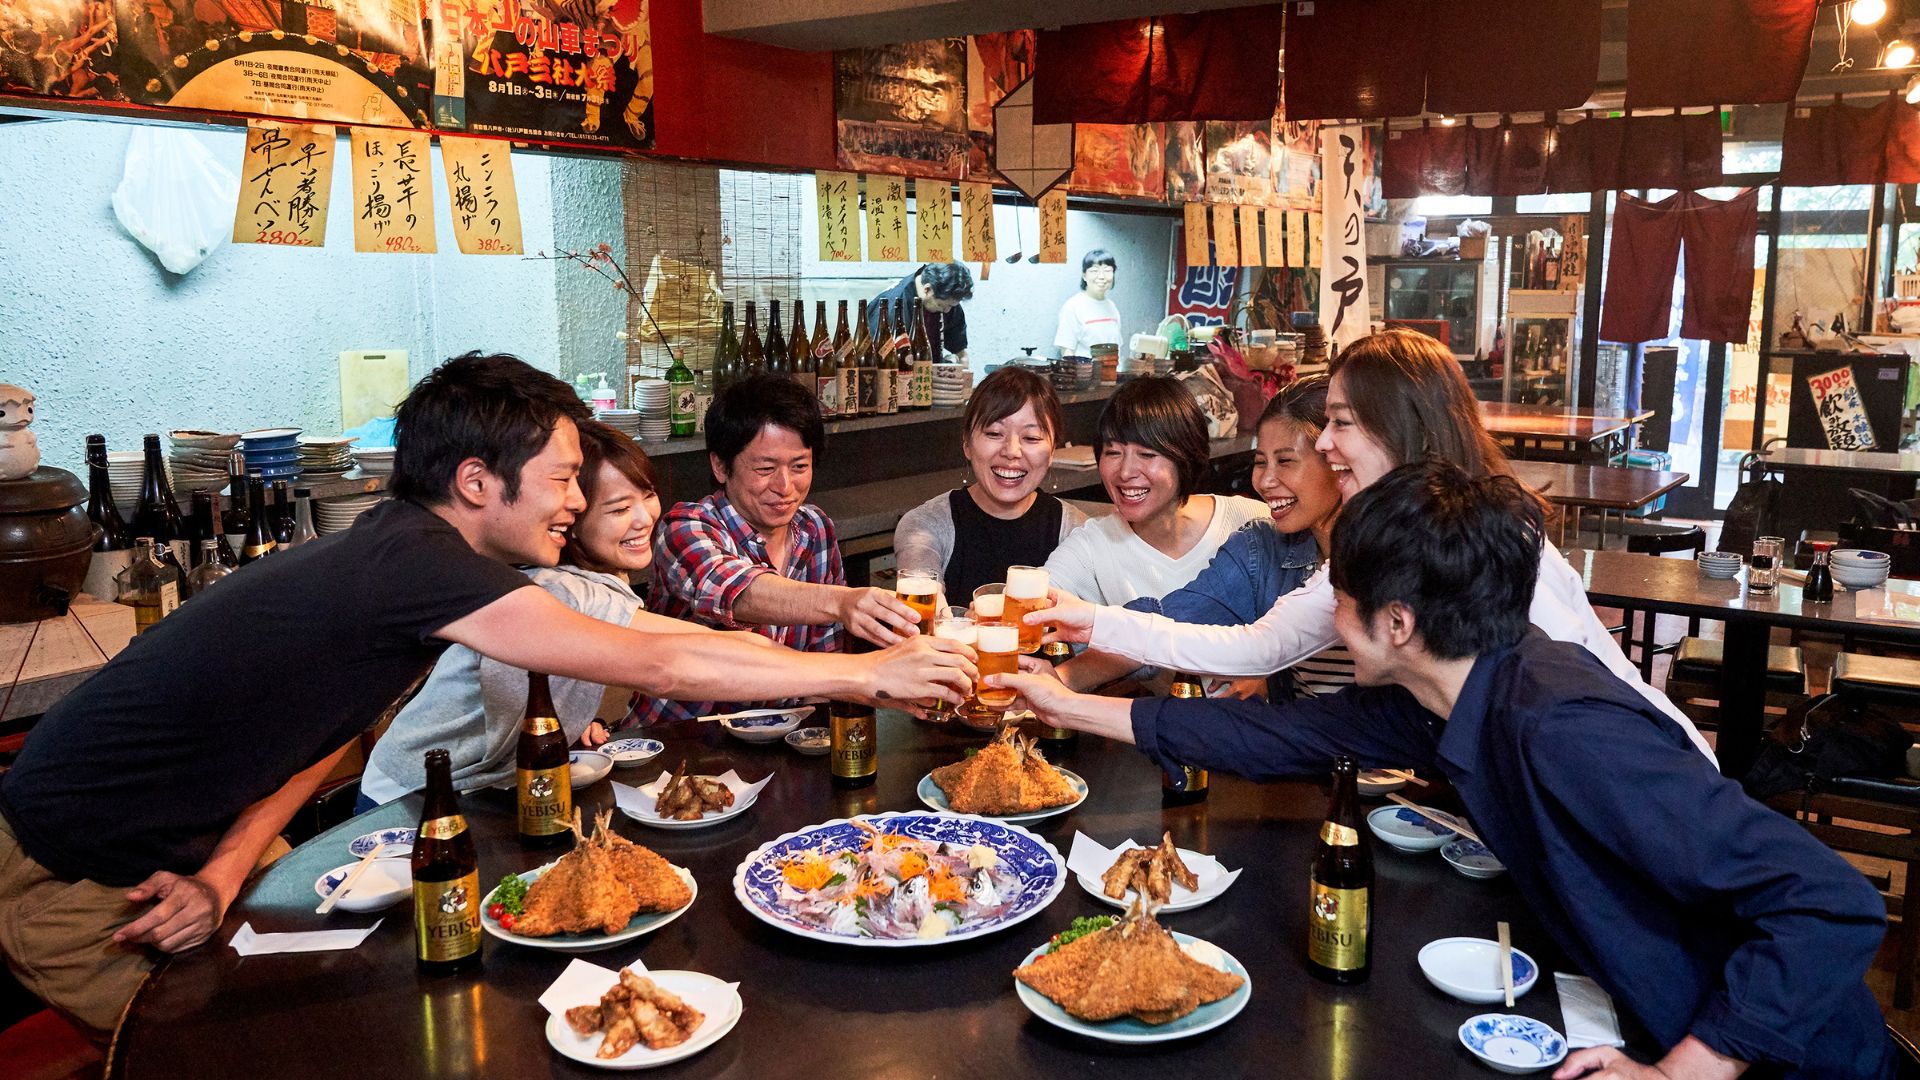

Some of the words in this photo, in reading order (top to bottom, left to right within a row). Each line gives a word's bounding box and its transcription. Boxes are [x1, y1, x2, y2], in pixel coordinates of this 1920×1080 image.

[250, 128, 291, 232] 骨せんべい
[289, 142, 326, 235] 早い者勝ち
[362, 140, 392, 239] ほっこり揚げ
[392, 140, 421, 232] 長芋の
[453, 160, 478, 232] 丸揚げ
[480, 152, 502, 235] ニンニクの
[385, 237, 423, 252] 480エン
[477, 238, 513, 251] 380エン
[1819, 392, 1861, 451] 飲み放題
[521, 801, 566, 817] YEBISU
[427, 916, 480, 939] YEBISU
[1309, 927, 1353, 948] EBISU
